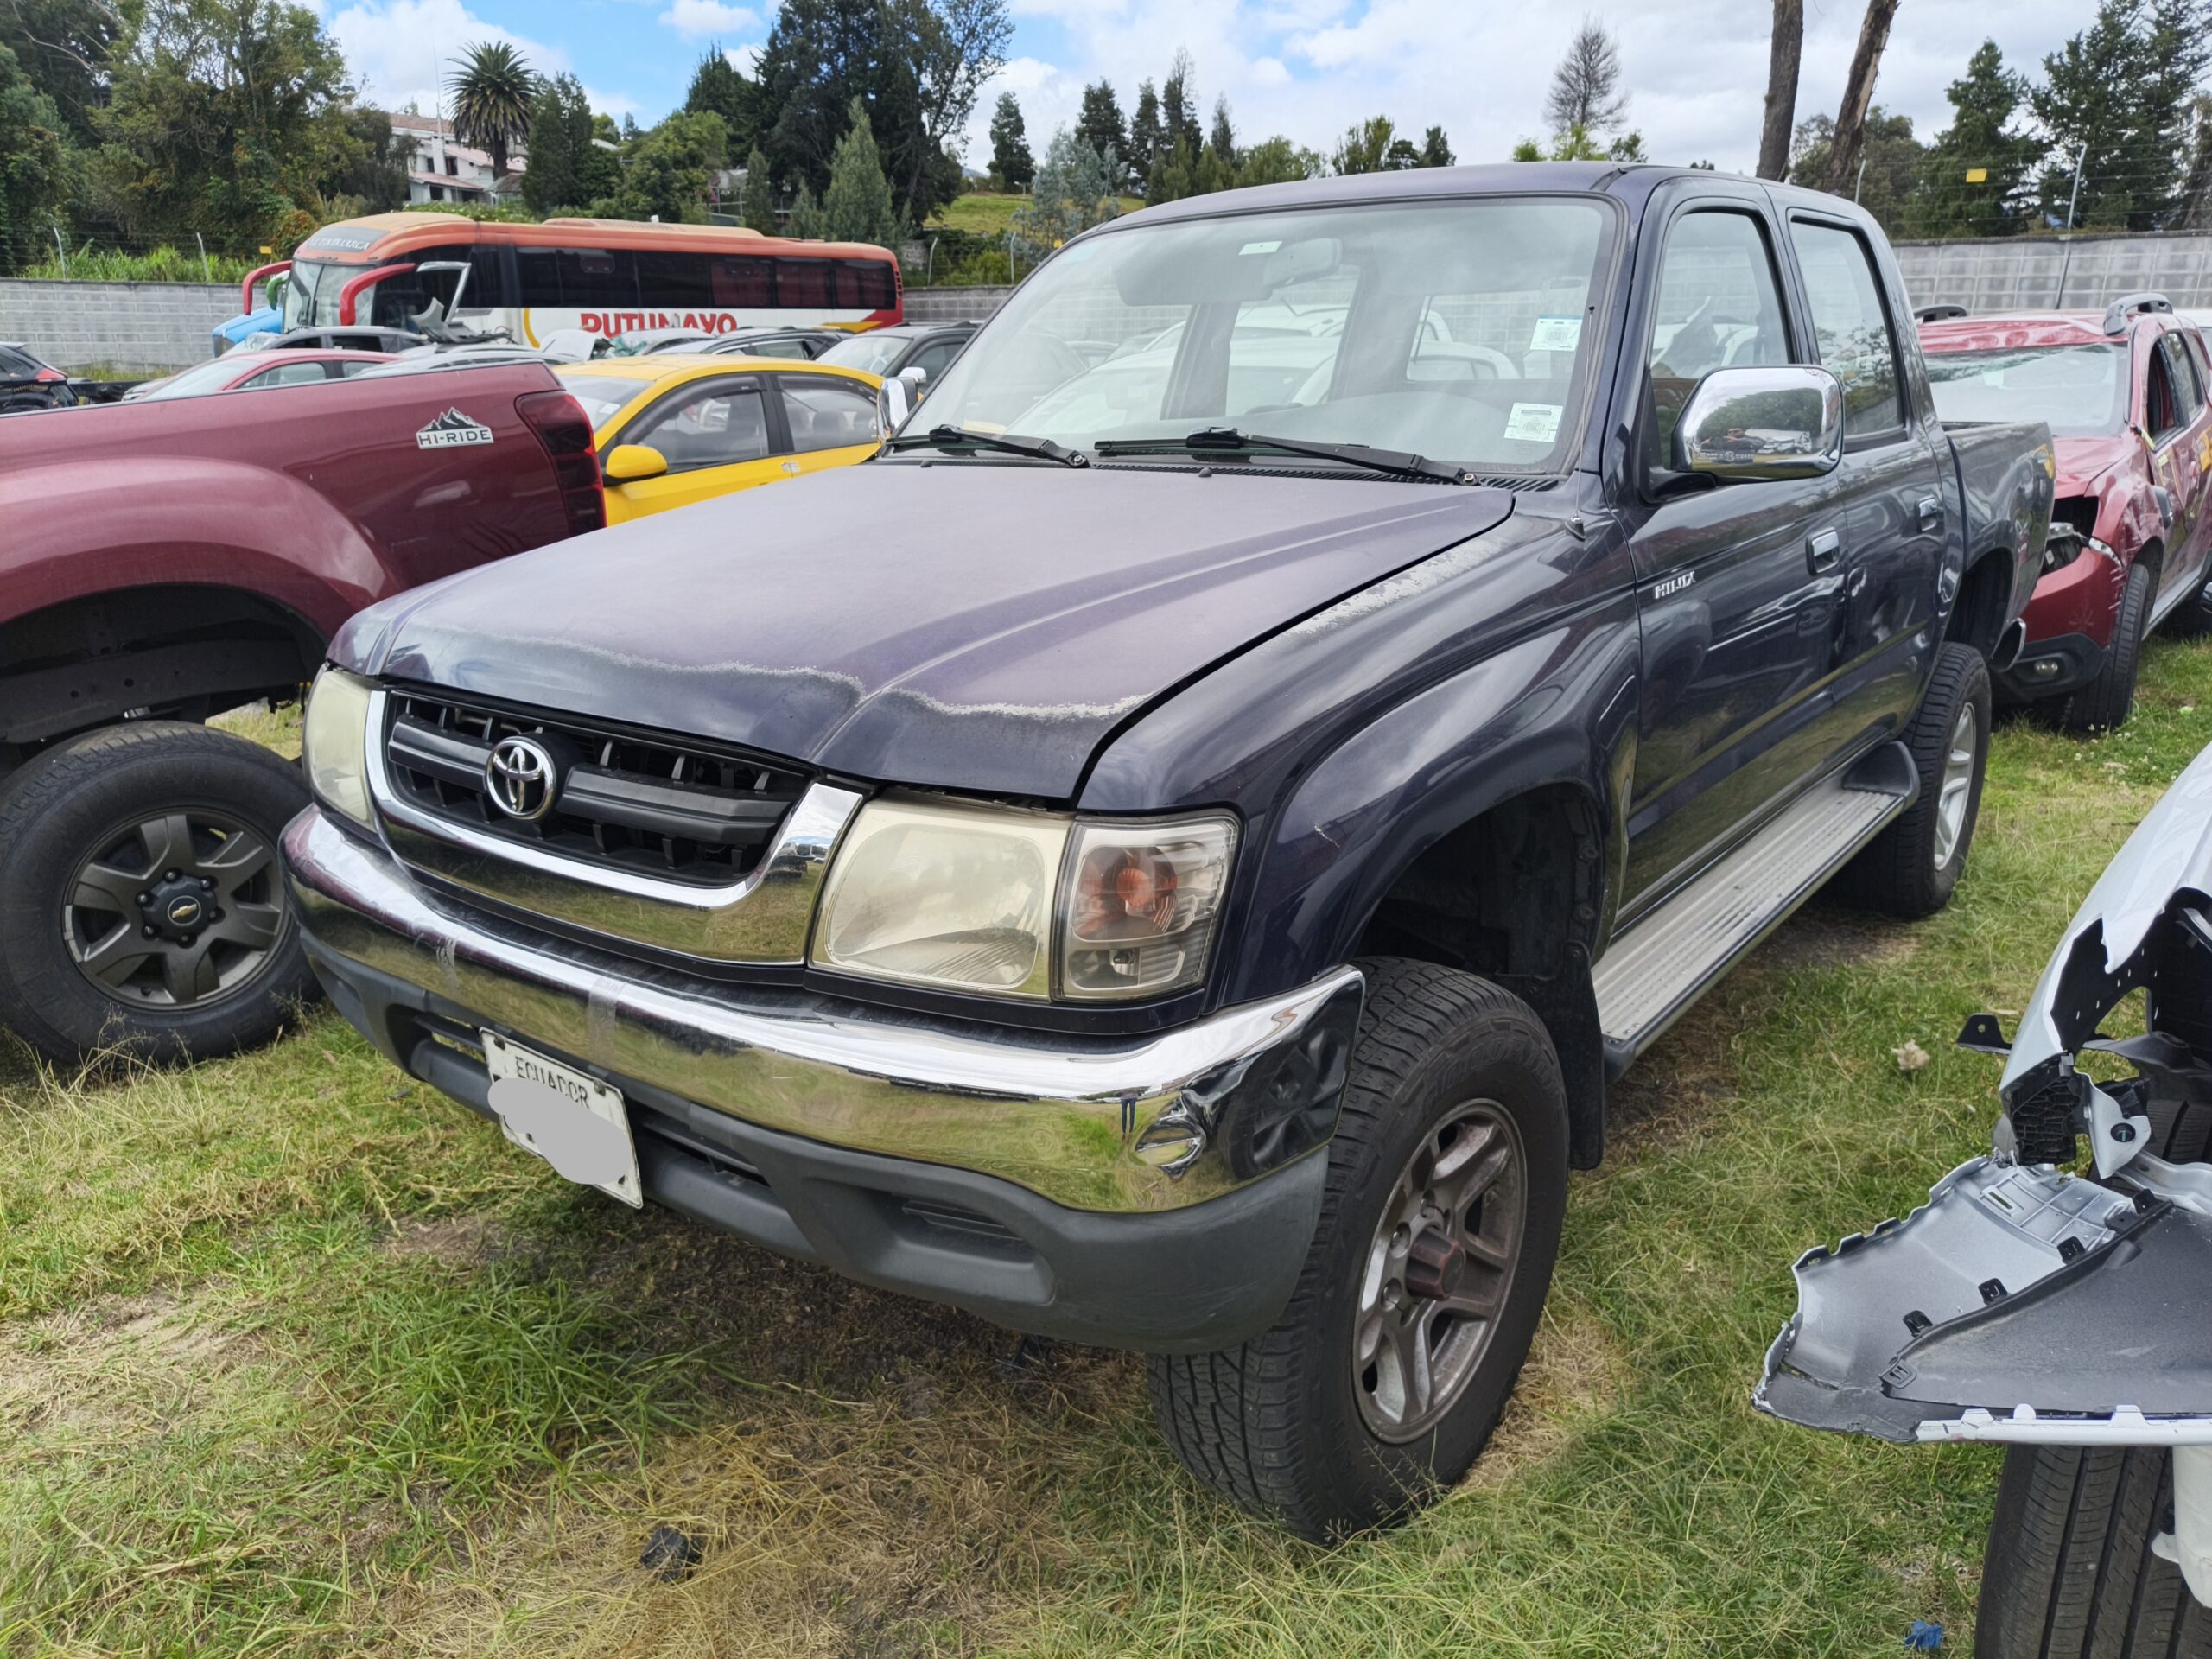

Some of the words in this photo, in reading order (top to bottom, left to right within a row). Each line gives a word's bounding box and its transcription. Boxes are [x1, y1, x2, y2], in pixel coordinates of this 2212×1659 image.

[580, 313, 737, 339] PUTUMAYO
[418, 429, 492, 446] HI-RIDE
[1655, 570, 1696, 600] HILUX
